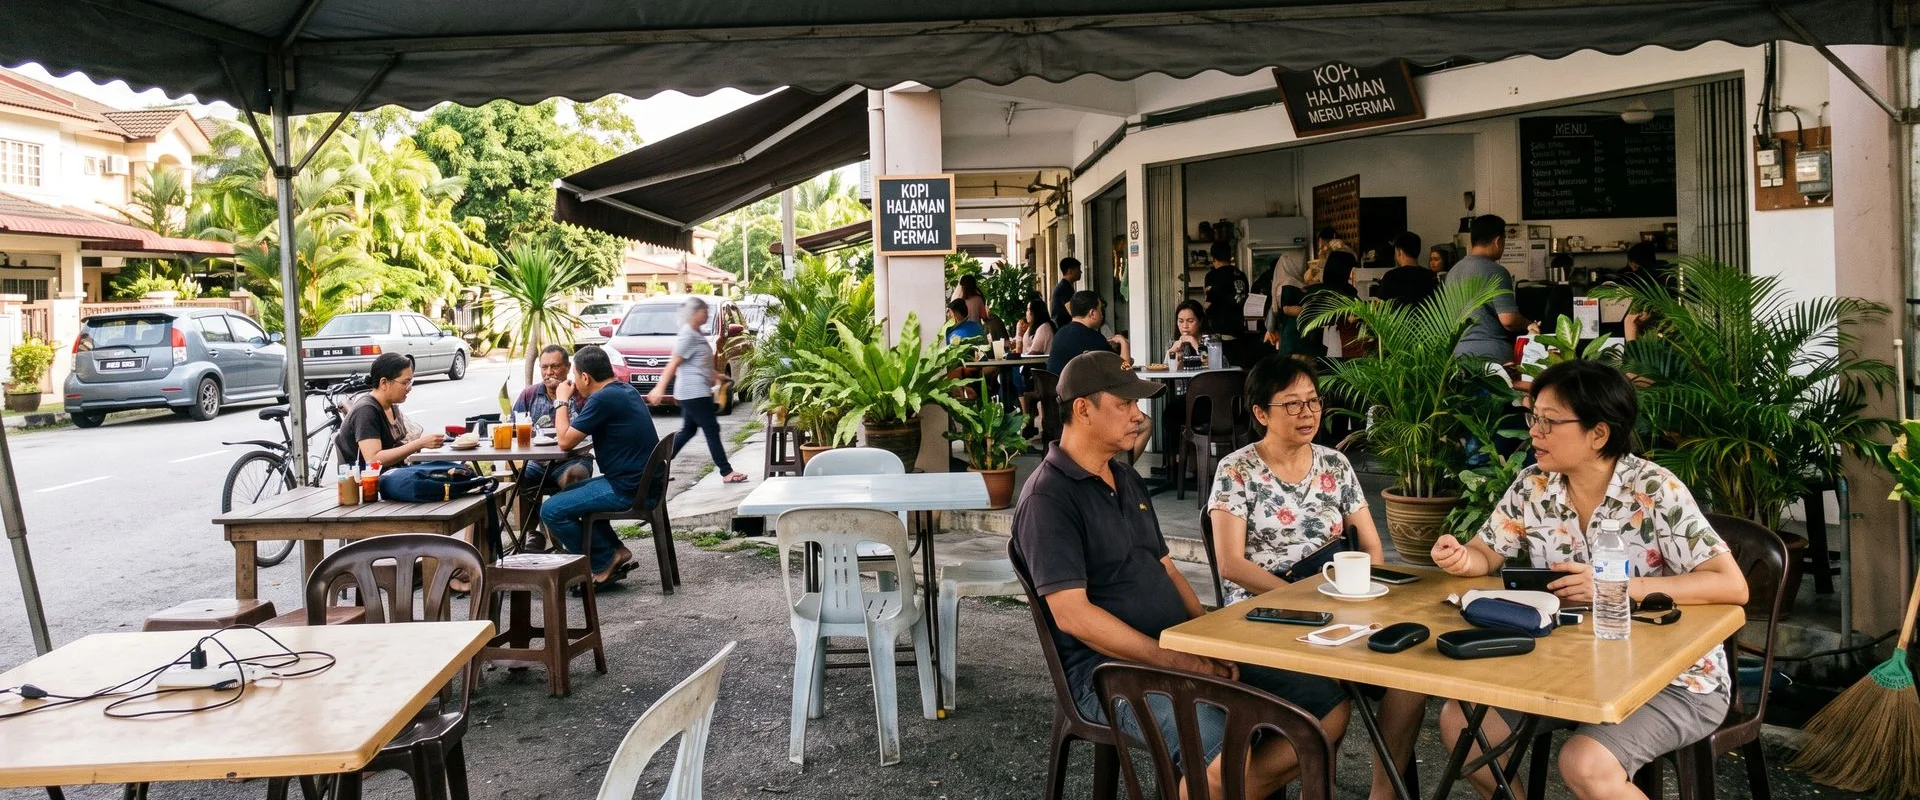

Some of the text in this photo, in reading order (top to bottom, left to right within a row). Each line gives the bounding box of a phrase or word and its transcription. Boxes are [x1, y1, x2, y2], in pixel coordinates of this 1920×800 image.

[1306, 78, 1386, 107] HALAMAN
[1308, 97, 1396, 124] MERU PERMAI
[1555, 122, 1588, 135] MENU
[901, 183, 929, 198] KOPI
[886, 199, 945, 214] HALAMAN
[899, 214, 933, 229] MERU
[893, 230, 939, 245] PERMAI
